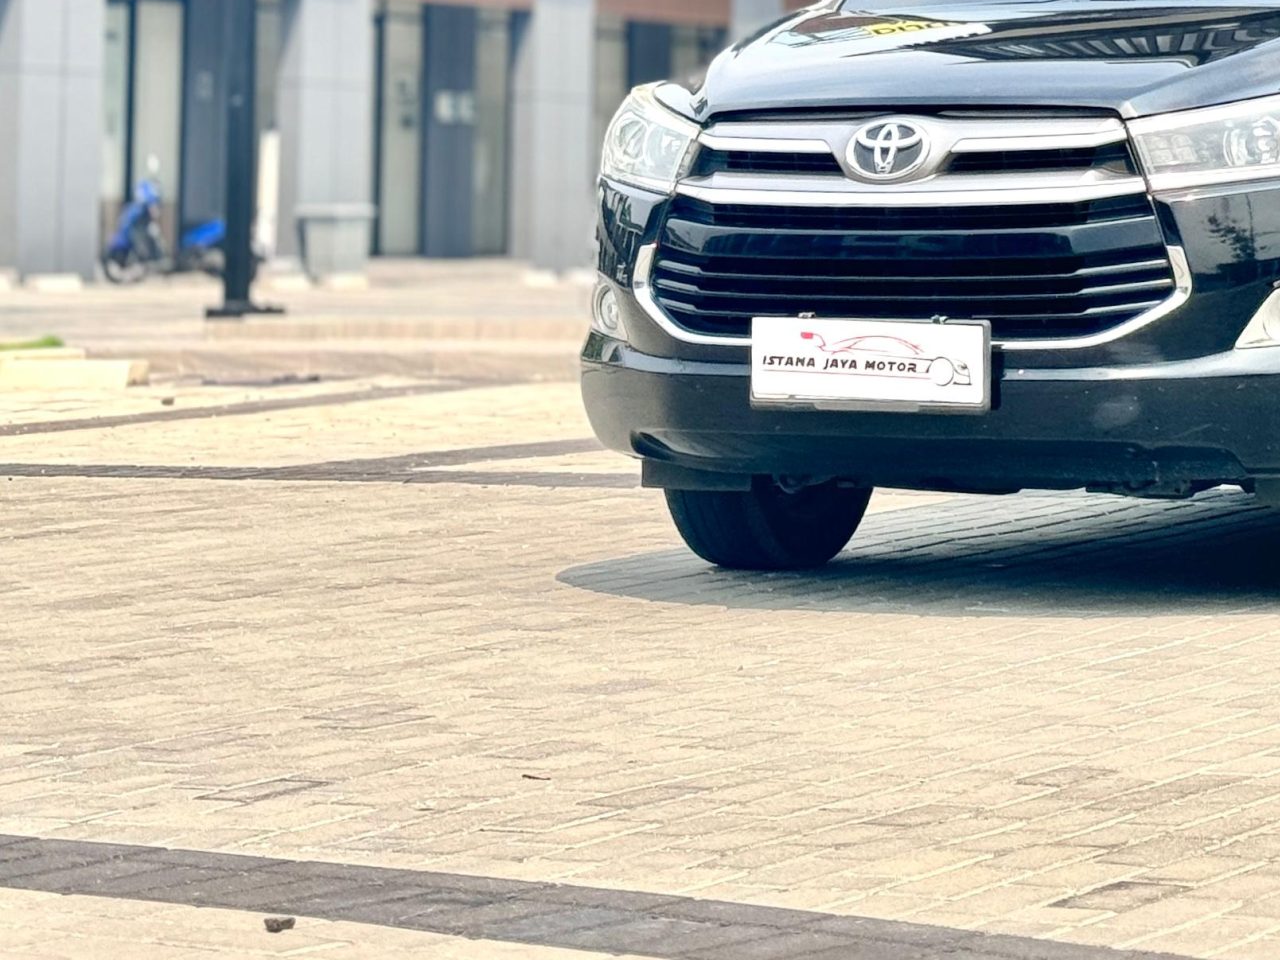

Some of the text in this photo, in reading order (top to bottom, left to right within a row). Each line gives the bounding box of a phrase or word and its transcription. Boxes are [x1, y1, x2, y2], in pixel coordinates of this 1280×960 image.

[762, 355, 917, 373] ISTANA JAYA MOTOR
